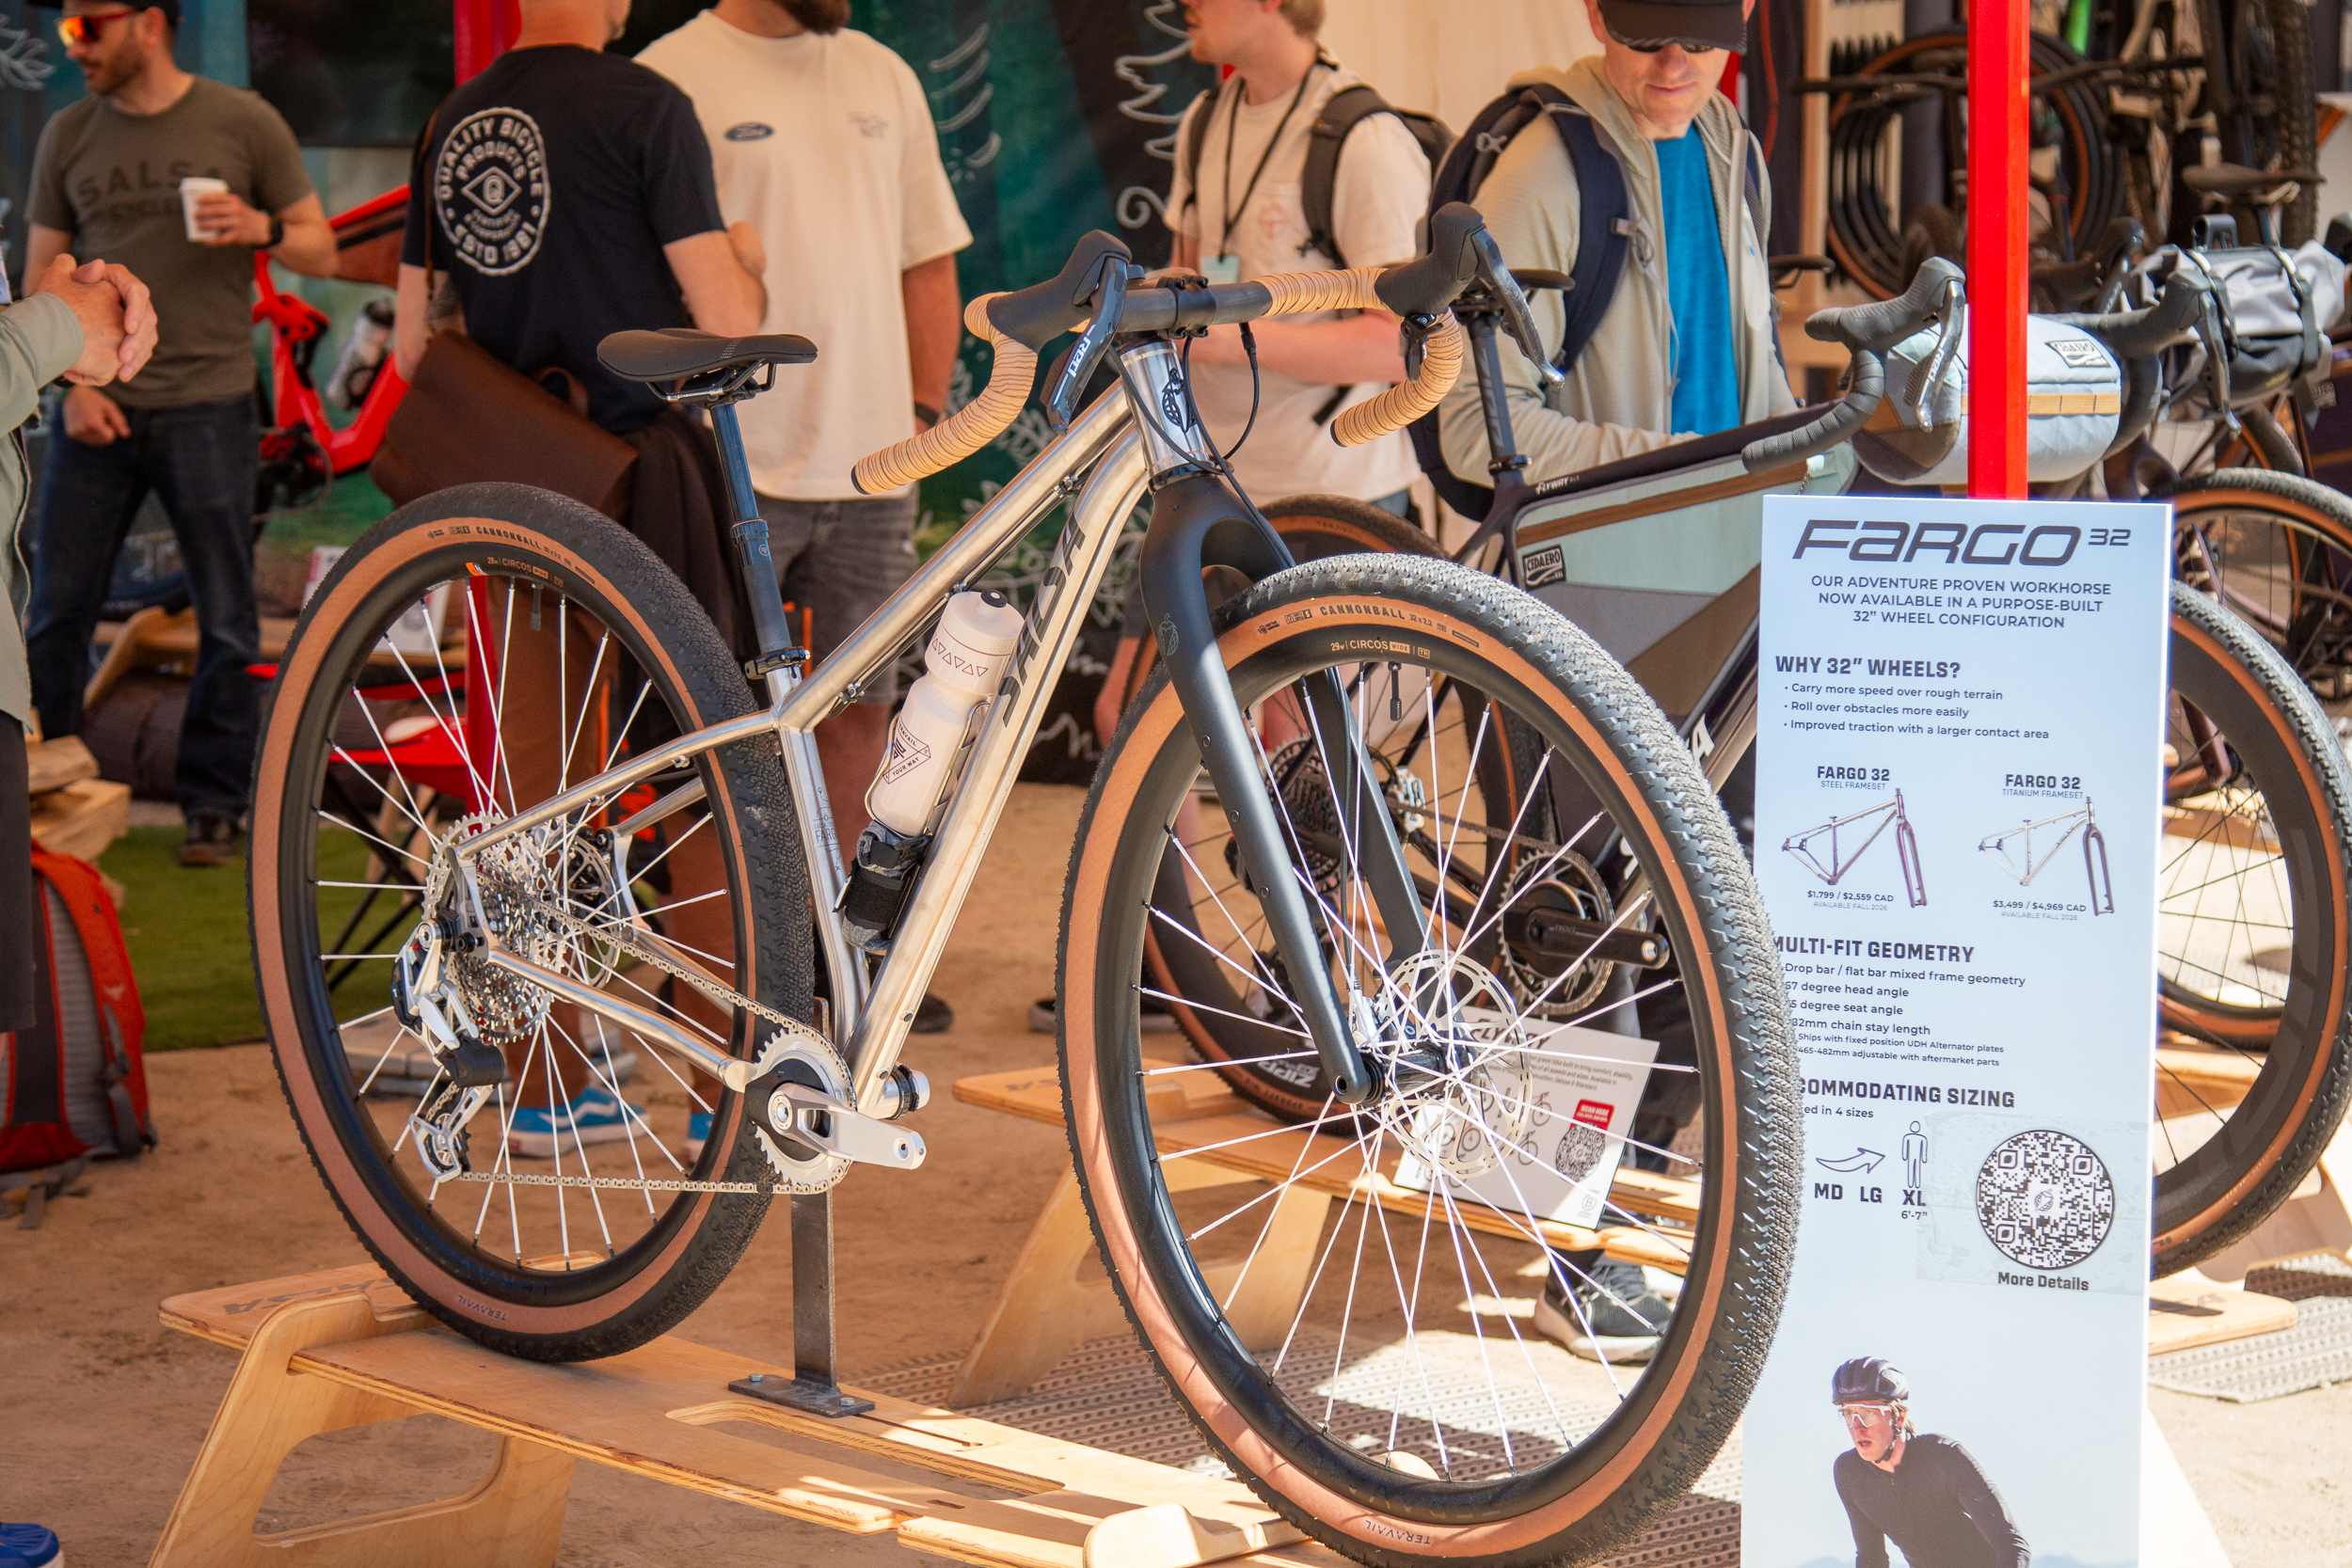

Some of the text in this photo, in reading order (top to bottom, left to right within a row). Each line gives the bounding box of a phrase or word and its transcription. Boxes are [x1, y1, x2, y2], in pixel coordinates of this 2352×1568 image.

[438, 117, 543, 201] QUALITY BICYCLE
[455, 141, 528, 182] PRODUCTS
[483, 175, 505, 206] Q
[476, 526, 541, 549] CANNONBALL
[2088, 529, 2131, 546] 32
[502, 558, 532, 572] CIRCOS
[1527, 549, 1561, 572] CEDAERO
[1811, 575, 2111, 594] OUR ADVENTURE PROVEN WORKHORSE
[1819, 593, 2104, 611] NOW AVAILABLE IN A PURPOSE-BUILT
[998, 512, 1087, 729] SALSA
[1320, 604, 1406, 620] CANNONBALL
[1881, 611, 1935, 624] WHEEL
[1939, 613, 2064, 628] CONFIGURATION
[1350, 640, 1389, 651] CIRCOS
[1391, 641, 1409, 653] WIDE
[1775, 656, 1821, 673] WHY
[1867, 659, 1961, 678] WHEELS?
[1791, 683, 2003, 700] Carry more speed over rough terrain
[1791, 701, 1969, 720] Roll over obstacles more easily
[1791, 720, 1845, 731] Improved
[1849, 722, 1894, 733] traction
[1898, 723, 1923, 734] with
[1937, 725, 1972, 737] larger
[1975, 728, 2020, 737] contact
[892, 756, 919, 777] YOUR WAY
[1818, 766, 1890, 782] FARGO 32
[1820, 780, 1886, 790] STEEL FRAMESET
[2006, 774, 2080, 789] FARGO 32
[2002, 788, 2084, 799] TITANIUM FRAMESET
[1807, 890, 1835, 899] $1,799
[1843, 892, 1871, 901] $2,559
[1874, 894, 1894, 902] CAD
[1994, 900, 2024, 909] $3,499
[2032, 902, 2063, 911] $4,969
[1867, 942, 1974, 962] GEOMETRY
[1785, 963, 1813, 974] Drop
[1817, 964, 1835, 974] bar
[1845, 966, 1865, 976] flat
[1867, 967, 1886, 977] bar
[1890, 969, 1926, 979] mixed
[1929, 971, 1964, 982] frame
[1967, 975, 2026, 988] geometry
[1801, 982, 1841, 994] degree
[1845, 984, 1873, 995] head
[1877, 988, 1909, 999] angle
[1788, 1000, 1903, 1017] 5 degree seat angle
[1831, 1021, 1862, 1031] chain
[1866, 1023, 1890, 1035] stay
[1893, 1023, 1931, 1037] length
[1798, 1033, 1821, 1042] Ships
[1845, 1036, 1867, 1044] fixed
[1869, 1037, 1905, 1046] position
[1930, 1041, 1975, 1051] Alternator
[1977, 1044, 2004, 1053] plates
[1852, 1050, 1898, 1060] adjustable
[1899, 1053, 1919, 1061] with
[1922, 1054, 1975, 1065] aftermarket
[1947, 1088, 2014, 1108] SIZING
[1821, 1105, 1874, 1118] in 4 sizes
[1814, 1182, 1926, 1207] MD LG XL
[1998, 1272, 2089, 1291] More Details
[457, 1293, 507, 1322] TERAVAIL
[1365, 1519, 1432, 1545] TERAVAIL
